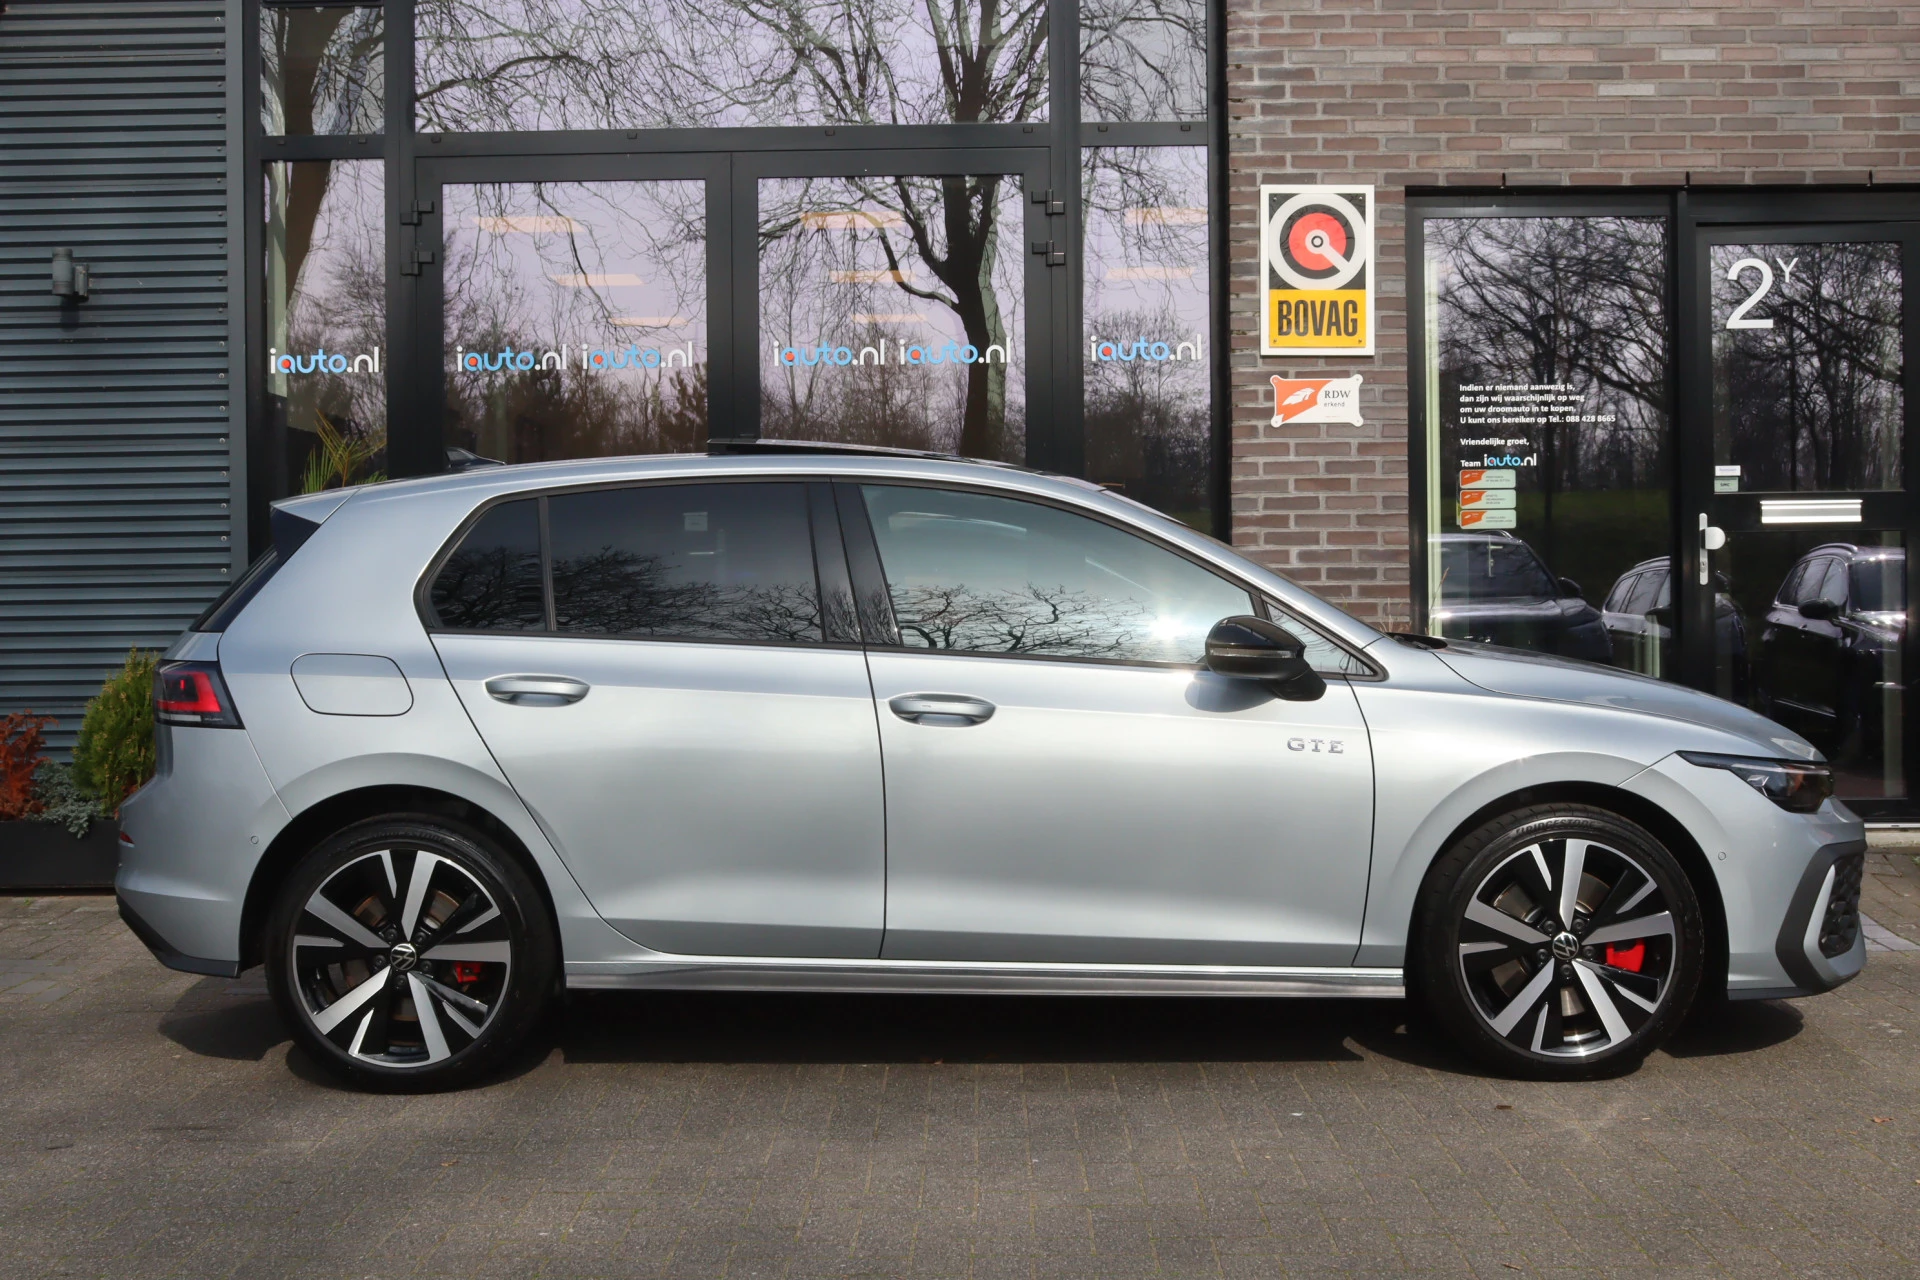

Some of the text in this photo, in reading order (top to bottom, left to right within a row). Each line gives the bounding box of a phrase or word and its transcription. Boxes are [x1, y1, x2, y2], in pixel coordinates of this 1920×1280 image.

[1277, 299, 1358, 337] BOVAG
[582, 341, 693, 369] iauto.nl
[773, 339, 885, 366] iauto.nl
[899, 336, 1011, 365] iauto.nl
[1090, 334, 1202, 362] iauto.nl
[270, 346, 380, 374] iauto.nl
[457, 344, 567, 372] iauto.nl
[1324, 390, 1351, 399] RDW
[1460, 383, 1484, 392] Indien
[1495, 383, 1529, 392] niemand
[1530, 383, 1566, 392] aanwezig
[1566, 382, 1576, 391] is,
[1460, 393, 1585, 404] dan zijn wij waarschijnlijk op weg
[1488, 405, 1531, 413] droomauto
[1532, 404, 1540, 412] in
[1550, 404, 1577, 413] kopen.
[1460, 416, 1467, 424] U
[1467, 416, 1486, 424] kunt
[1502, 415, 1536, 423] bereiken
[1549, 415, 1565, 423] Tel.:
[1566, 415, 1580, 423] 088
[1597, 414, 1616, 422] 8665
[1460, 437, 1530, 447] Vriendelijke groet,
[1460, 453, 1537, 467] Team iauto.nl
[1287, 737, 1344, 754] GTE
